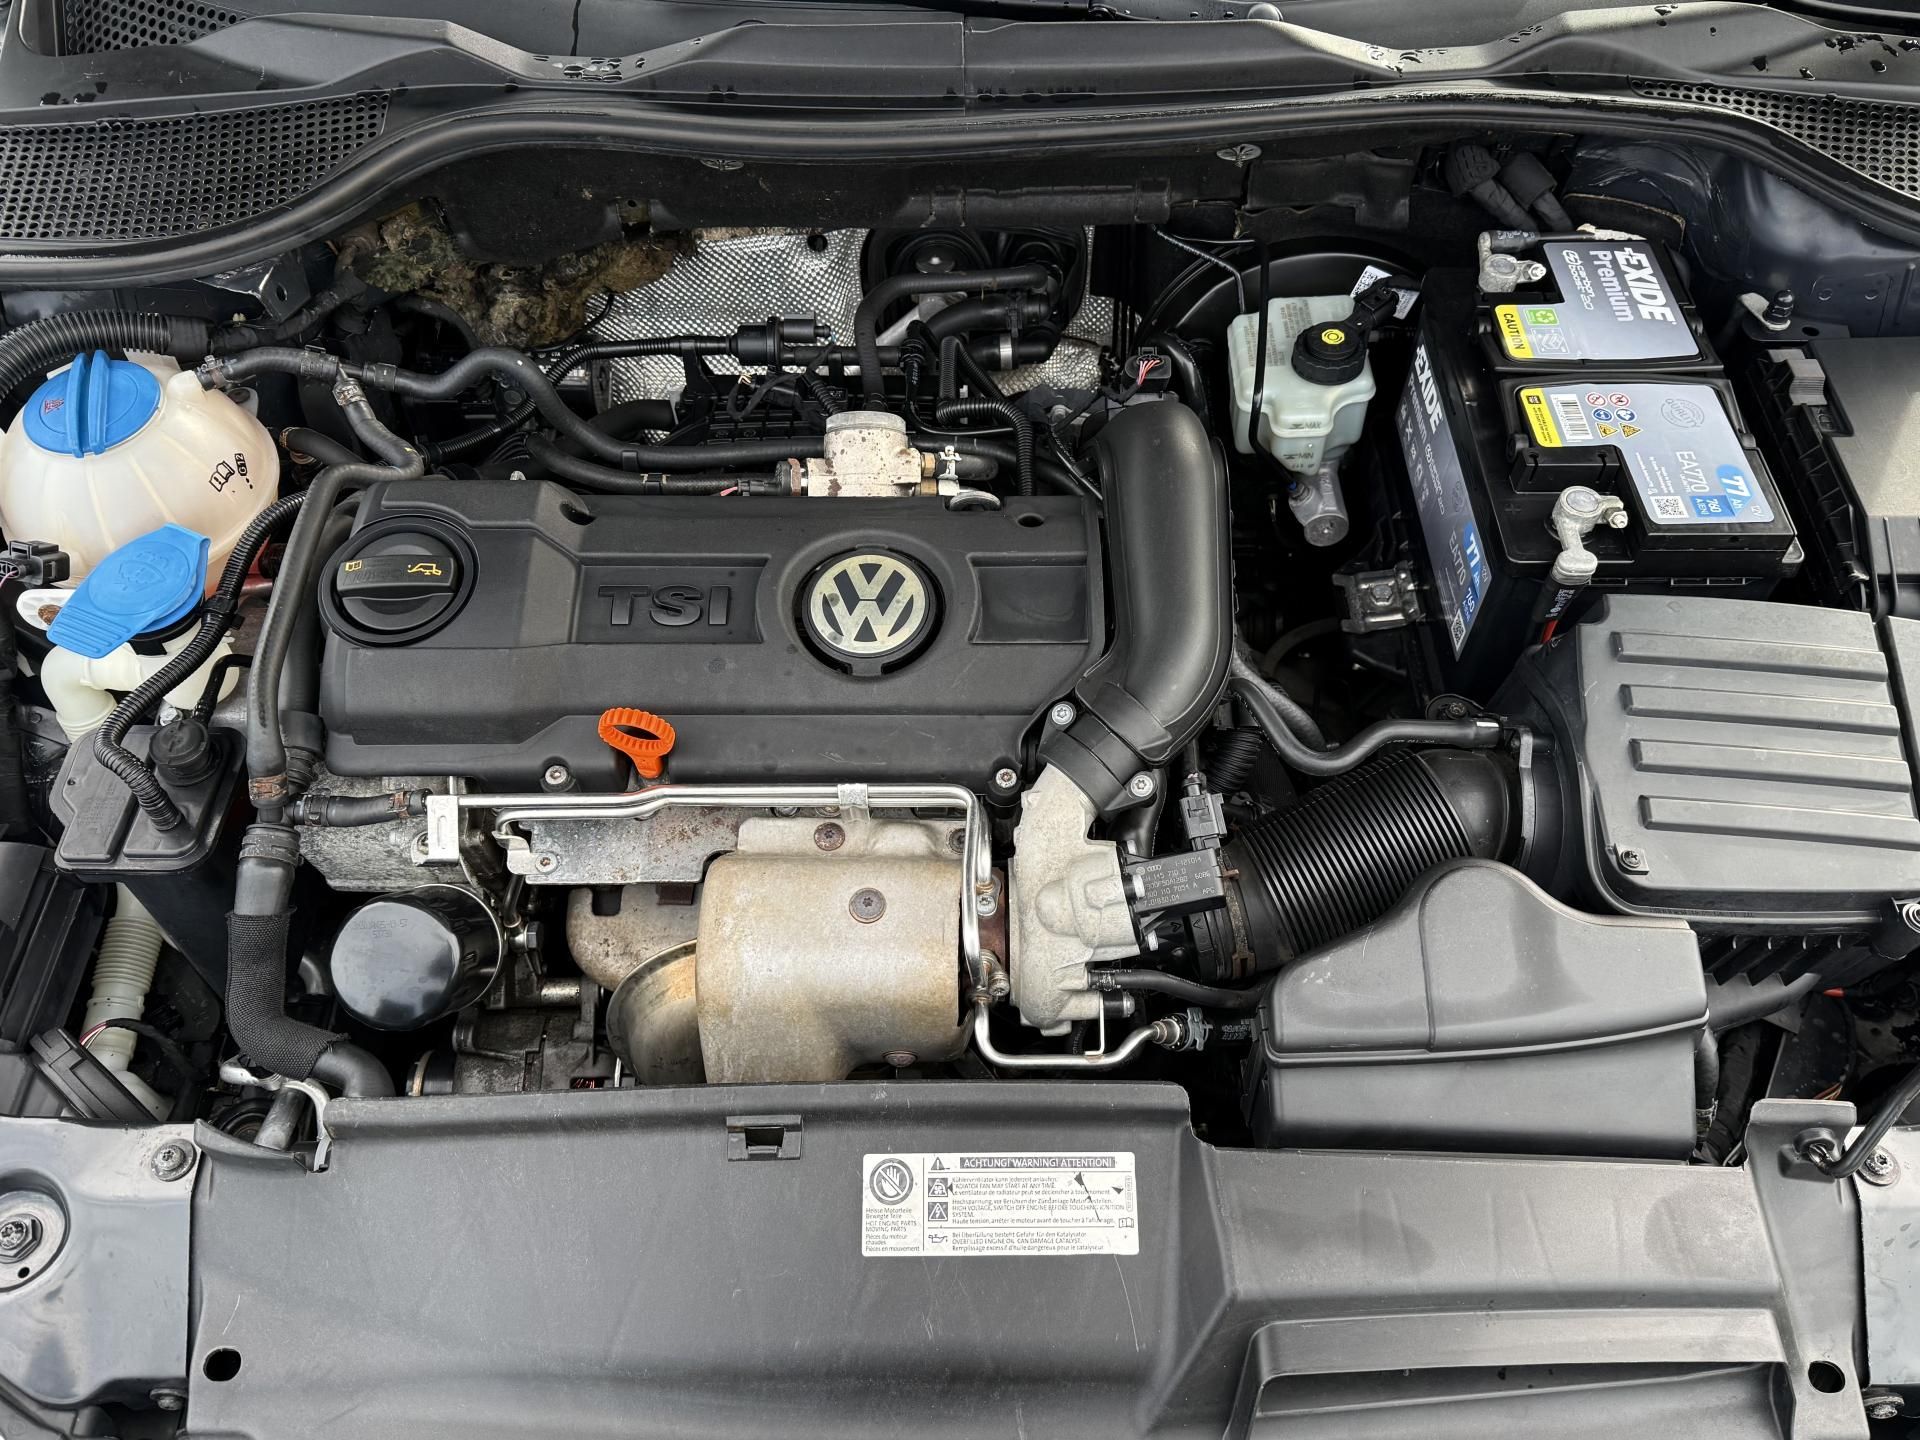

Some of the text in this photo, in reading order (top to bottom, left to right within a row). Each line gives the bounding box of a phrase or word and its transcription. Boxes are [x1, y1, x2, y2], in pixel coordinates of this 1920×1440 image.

[1578, 265, 1595, 298] carbon
[1589, 250, 1634, 322] Premium
[1613, 247, 1677, 322] EXIDE
[1503, 313, 1526, 350] CAUTION
[1407, 371, 1428, 444] Premium
[1415, 344, 1444, 435] EXIDE
[1304, 421, 1322, 429] MAX
[1664, 398, 1702, 428] QUALITY
[235, 454, 247, 475] G12
[1675, 450, 1710, 493] EA770
[1707, 498, 1722, 513] 760
[1720, 475, 1751, 509] 77 Ah
[1449, 530, 1466, 586] EA770
[1466, 532, 1480, 568] 77
[598, 584, 732, 626] TSI
[1466, 587, 1475, 613] 760
[963, 1158, 1112, 1168] ACHTUNG! WARNING! ATTENTION!
